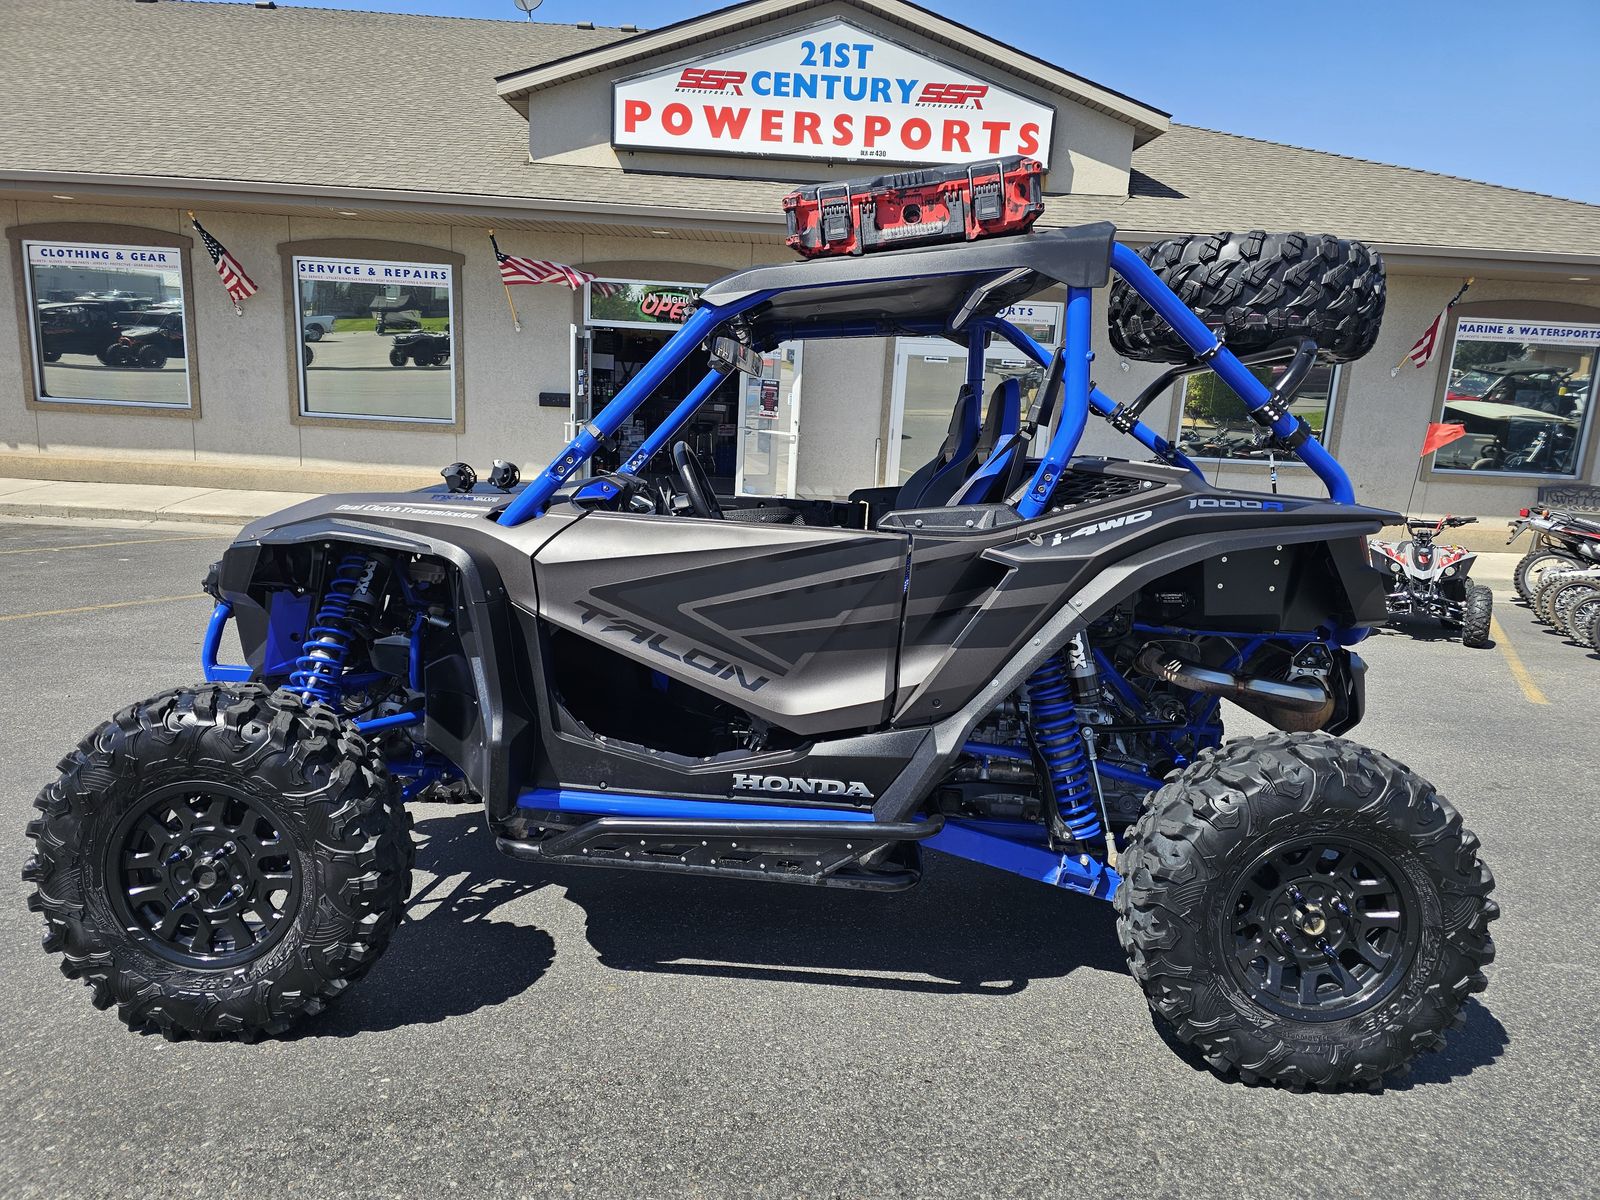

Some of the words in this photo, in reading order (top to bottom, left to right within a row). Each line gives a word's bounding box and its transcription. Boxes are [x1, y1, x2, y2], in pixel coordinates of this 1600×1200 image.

[800, 40, 873, 70] 21ST
[677, 68, 748, 96] SSR
[751, 71, 919, 104] CENTURY
[917, 83, 989, 110] SSR
[623, 99, 1040, 156] POWERSPORTS
[40, 248, 109, 260] CLOTHING
[115, 252, 124, 260] &
[130, 252, 167, 262] GEAR
[300, 263, 360, 275] SERVICE
[368, 267, 376, 276] &
[384, 268, 447, 280] REPAIRS
[641, 296, 687, 321] OPE
[1458, 324, 1503, 334] MARINE
[1506, 326, 1515, 334] &
[1520, 327, 1600, 339] WATERSPORTS
[335, 504, 364, 512] Dual
[364, 504, 402, 513] Clutch
[400, 507, 479, 519] Transmission
[1051, 510, 1153, 547] i-4WD
[574, 600, 771, 693] TALON
[733, 774, 874, 798] HONDA
